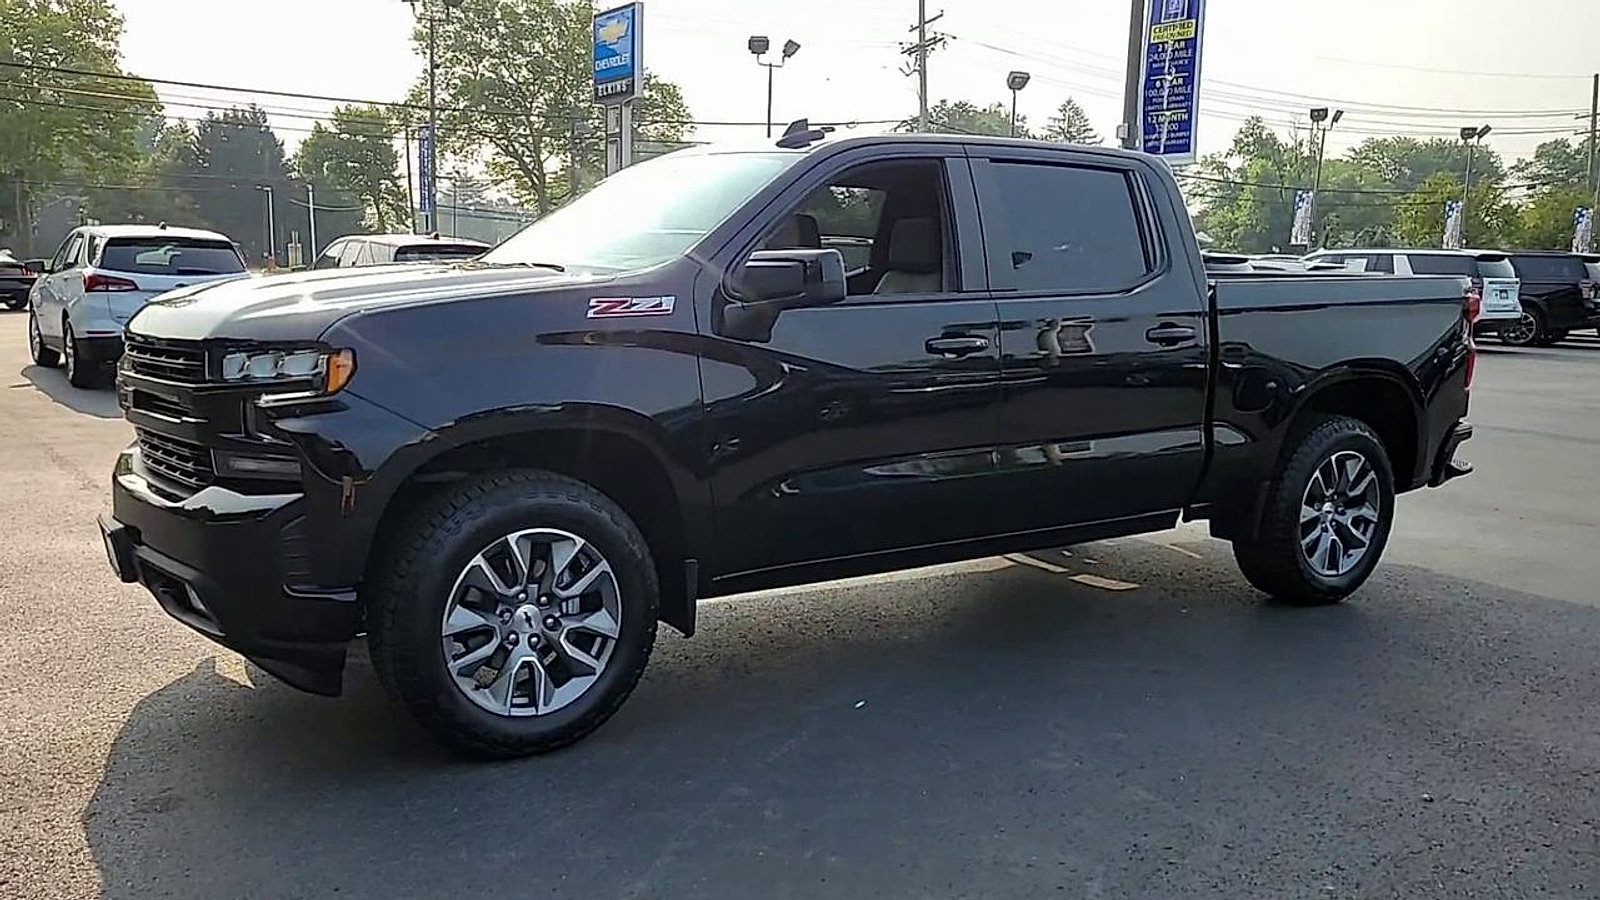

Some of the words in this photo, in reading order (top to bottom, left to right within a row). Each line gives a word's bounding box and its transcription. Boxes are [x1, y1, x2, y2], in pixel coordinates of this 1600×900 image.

[1153, 21, 1194, 34] CERTIFIED
[1157, 43, 1163, 52] 2
[594, 53, 629, 71] CHEVROLET
[1155, 80, 1161, 89] 6
[1145, 87, 1173, 98] 100,00
